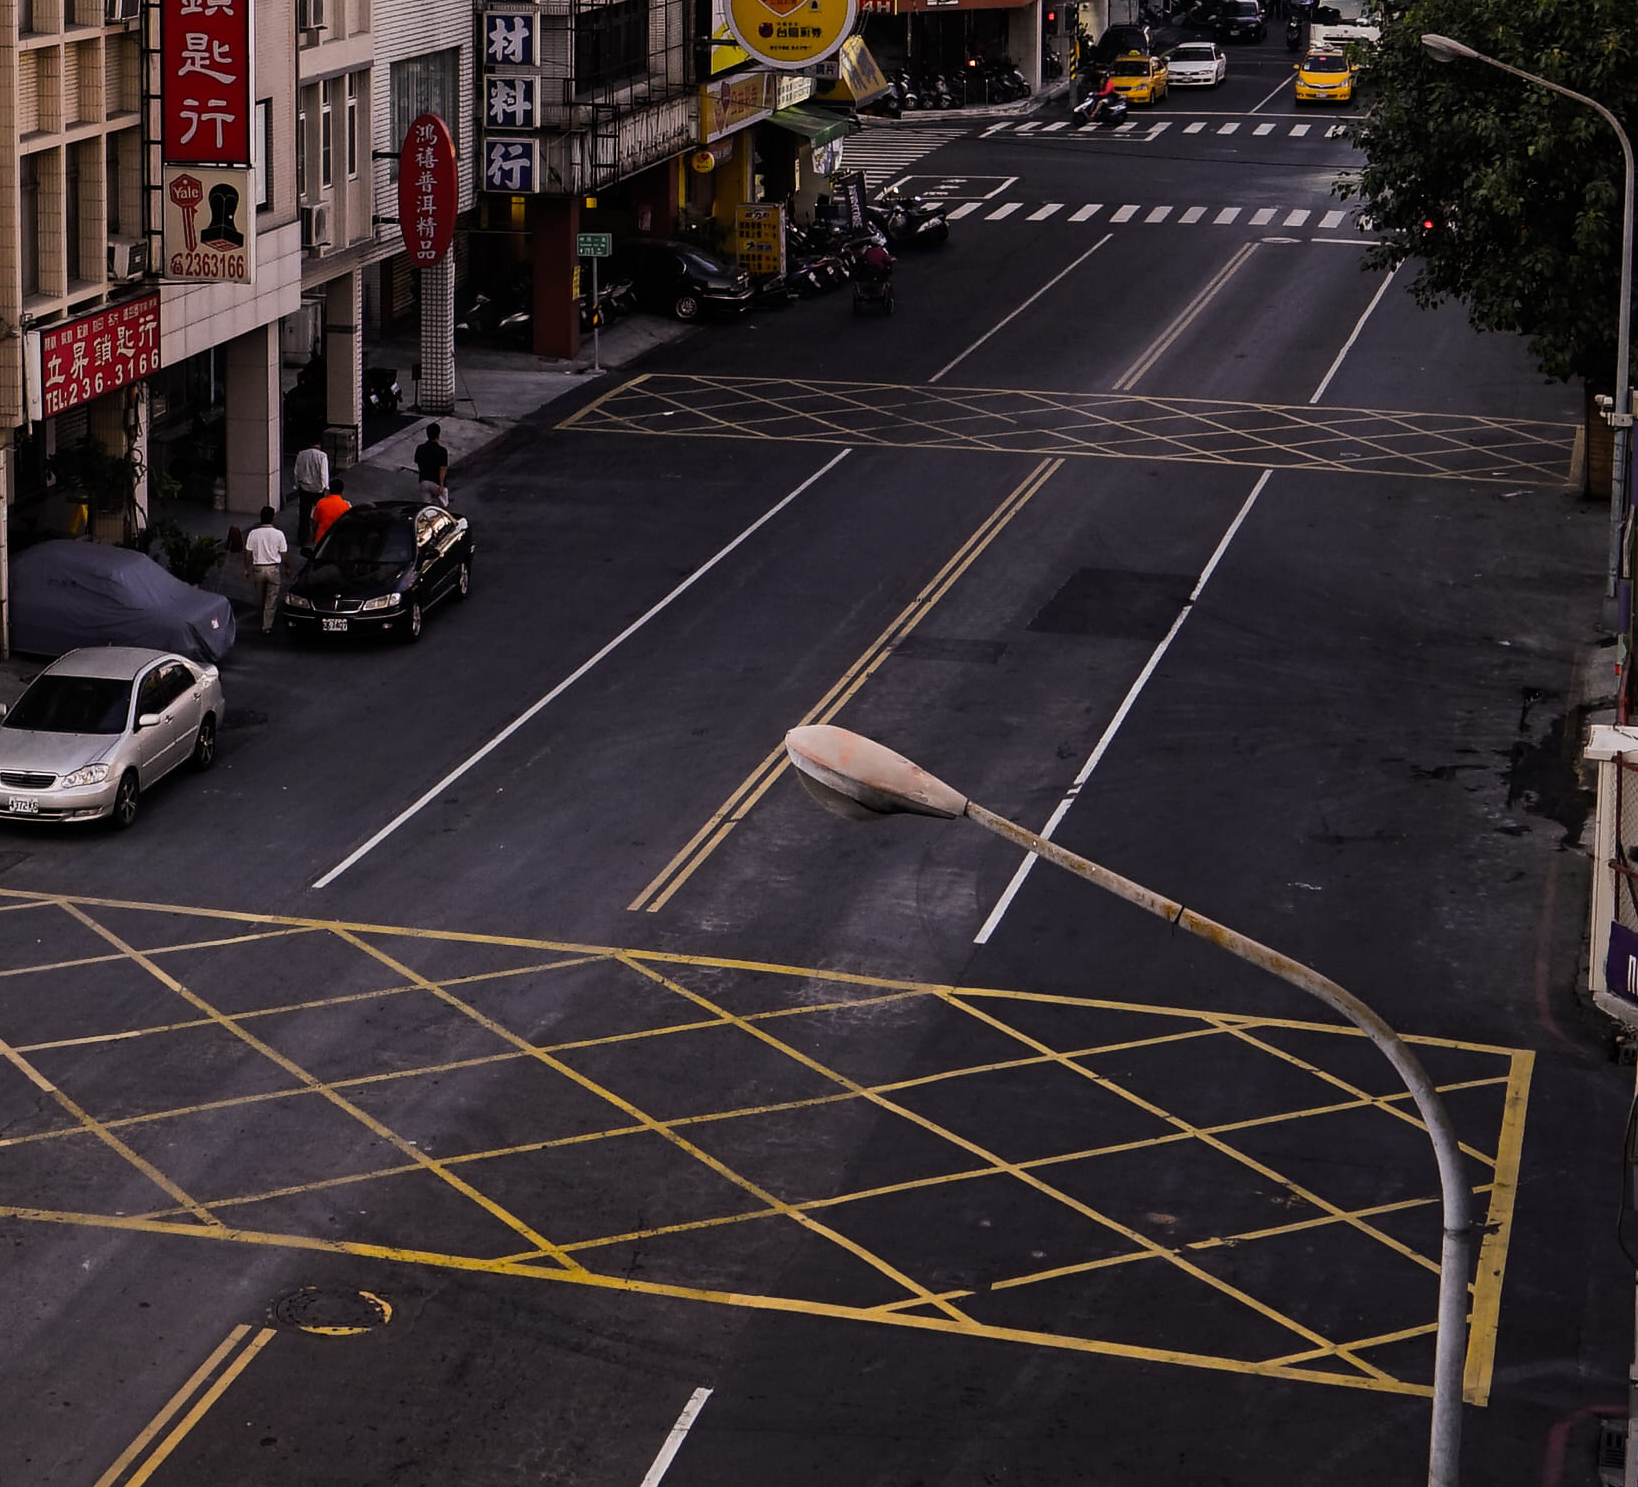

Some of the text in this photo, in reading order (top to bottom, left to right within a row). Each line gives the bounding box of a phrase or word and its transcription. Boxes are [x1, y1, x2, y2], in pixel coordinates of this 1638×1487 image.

[172, 186, 199, 199] Yale
[415, 123, 439, 260] 鴻禧普洱精品
[185, 252, 245, 279] 2363166
[45, 314, 158, 388] 立昇鎖匙行
